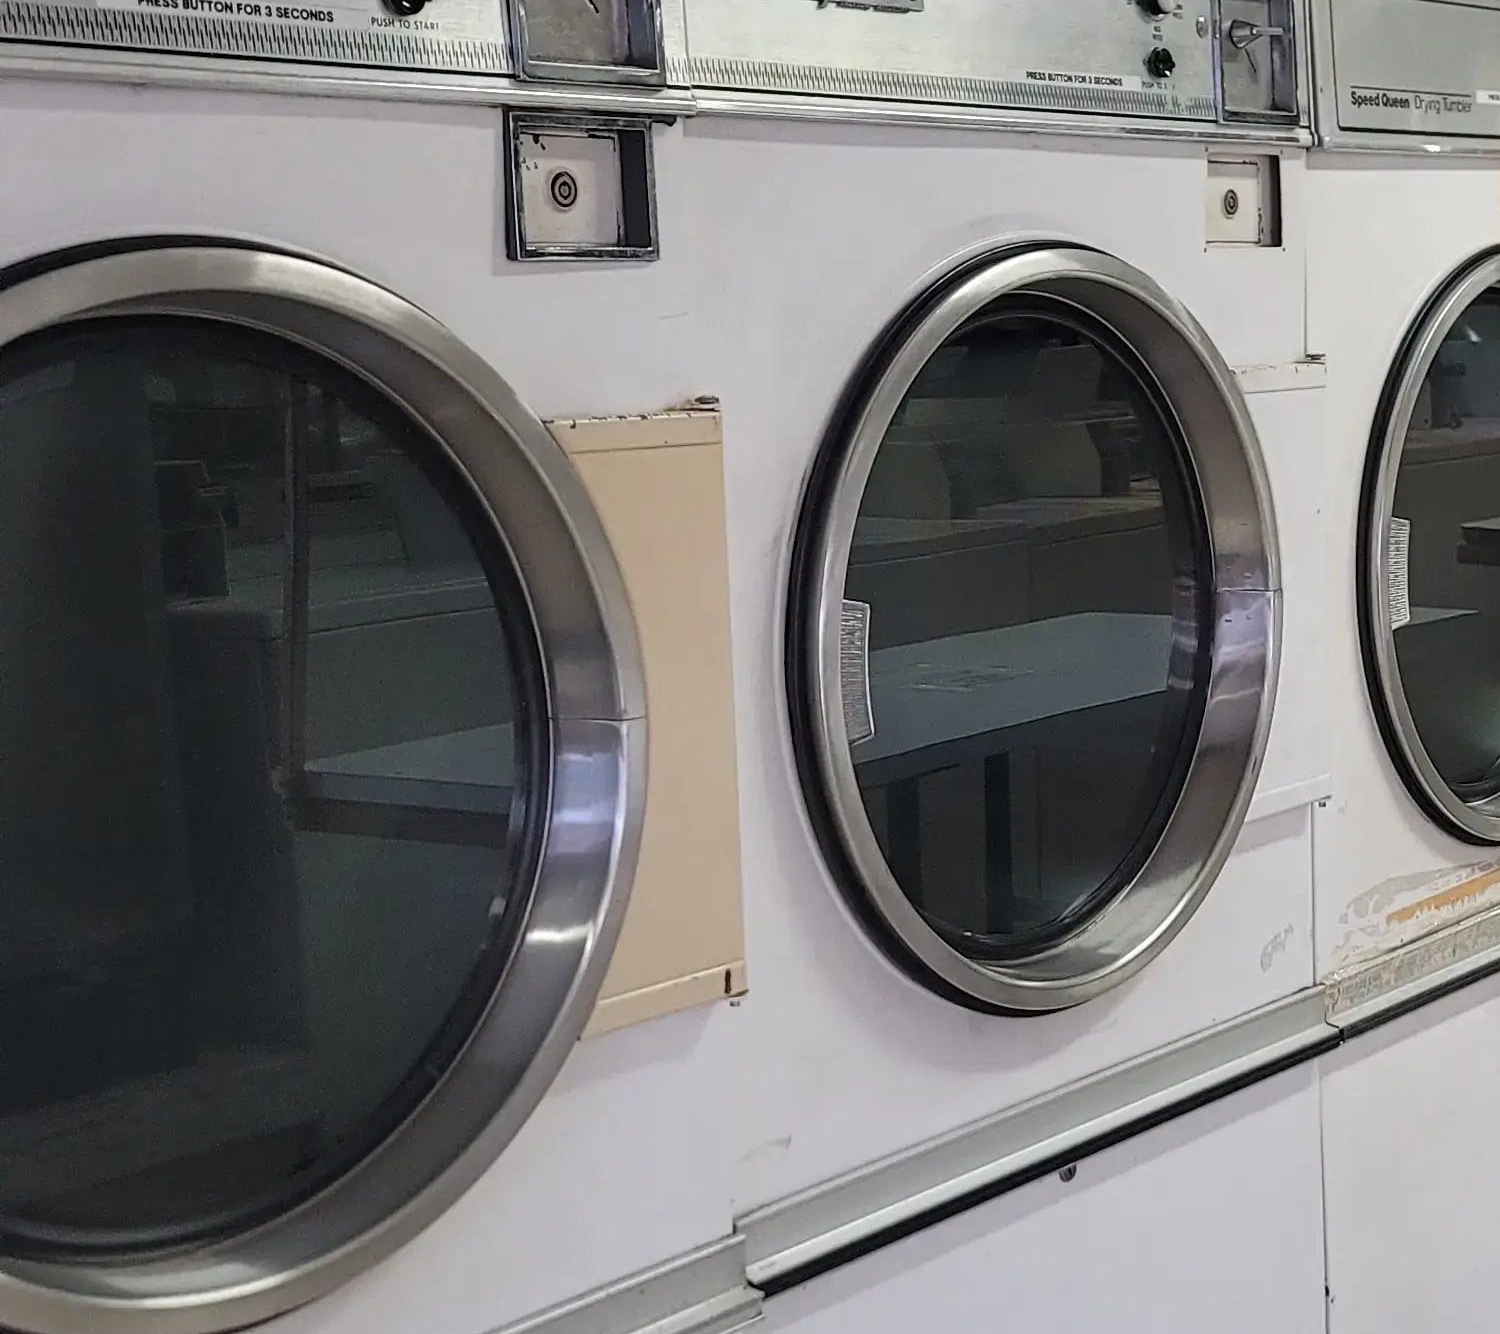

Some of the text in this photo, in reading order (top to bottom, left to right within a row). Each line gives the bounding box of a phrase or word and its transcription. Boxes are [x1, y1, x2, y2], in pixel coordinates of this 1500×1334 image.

[237, 3, 261, 17] FOR
[265, 5, 272, 18] 3
[276, 7, 334, 23] SECONDS
[371, 17, 395, 28] PUSH
[398, 18, 411, 30] TO
[1026, 70, 1046, 81] PRESS
[1048, 73, 1073, 83] BUTTON
[1074, 75, 1087, 84] FOR
[1093, 77, 1123, 87] SECONDS
[1350, 91, 1472, 114] Speed Queen Drying Tumbler
